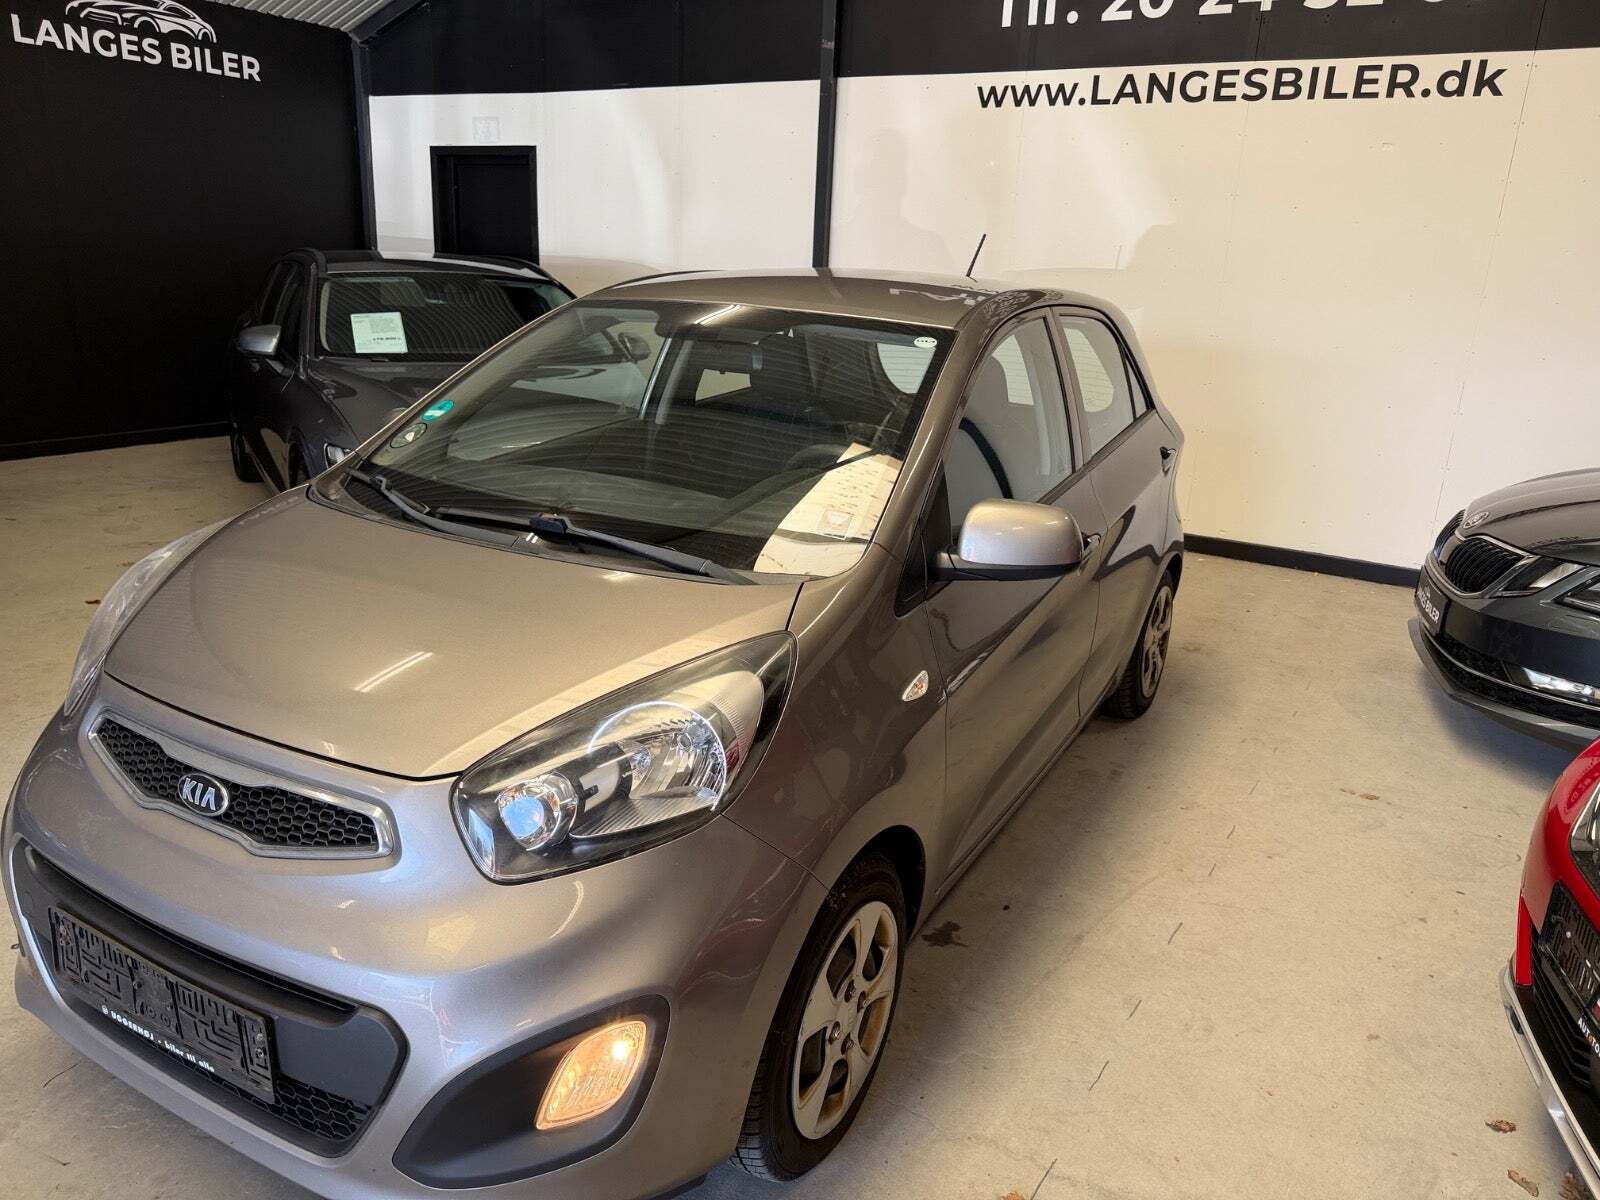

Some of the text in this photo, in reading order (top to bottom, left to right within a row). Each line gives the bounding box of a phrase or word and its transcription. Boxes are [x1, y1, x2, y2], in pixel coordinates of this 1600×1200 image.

[10, 13, 262, 82] LANGES BILER
[976, 59, 1508, 108] www.LANGESBILER.dk
[182, 777, 216, 811] KIA
